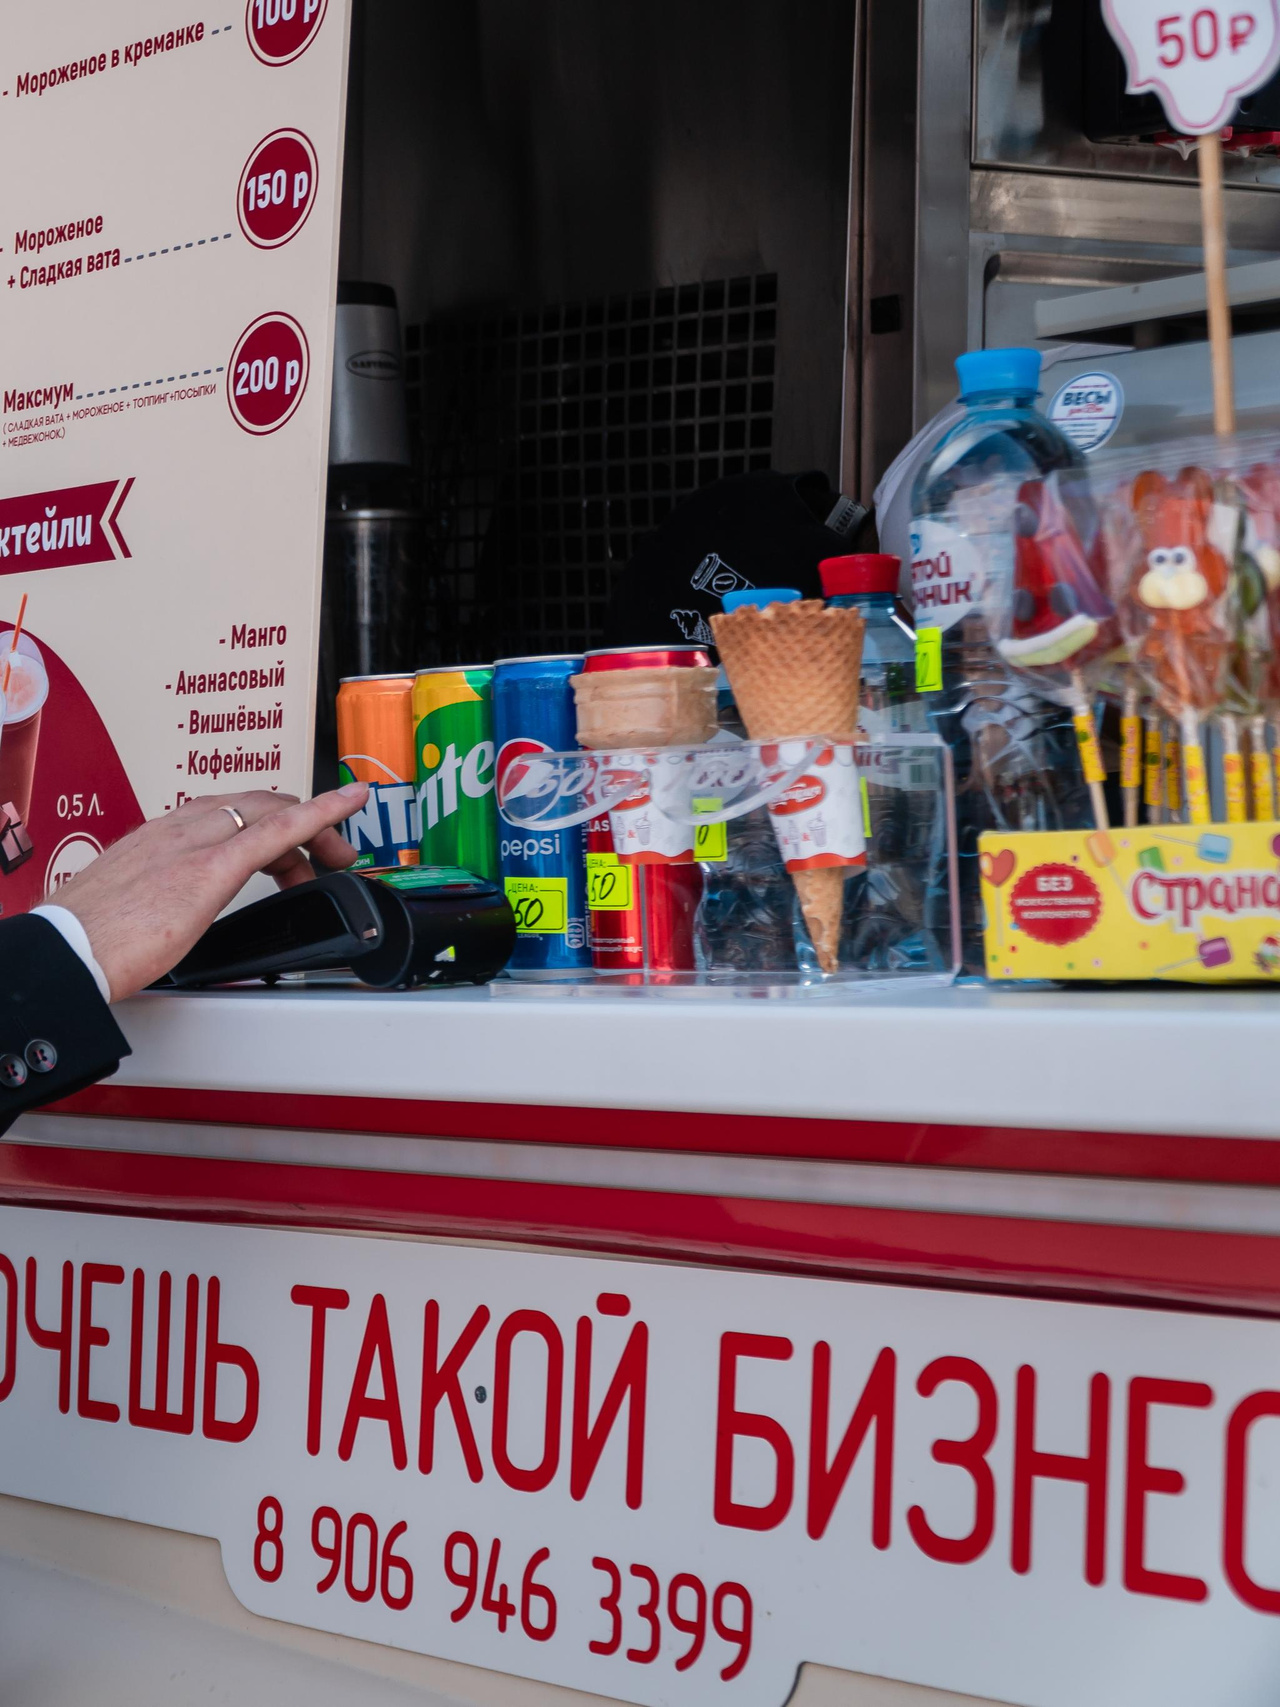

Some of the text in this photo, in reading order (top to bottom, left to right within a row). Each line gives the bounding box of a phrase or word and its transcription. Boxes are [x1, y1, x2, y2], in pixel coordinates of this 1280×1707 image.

[254, 0, 300, 30] 100
[16, 22, 204, 98] Мороженое в креманке
[246, 169, 287, 211] 150
[15, 215, 103, 254] Мороженое
[20, 258, 82, 290] Сладкая
[87, 248, 121, 273] вата
[236, 356, 280, 396] 200
[3, 382, 74, 413] Максмум
[8, 416, 44, 433] СЛАДКАЯ
[46, 412, 65, 425] ВАТА
[72, 401, 124, 420] МОРОЖЕНОЕ
[133, 392, 169, 408] ТОППИНГ
[231, 624, 287, 650] Манго
[175, 660, 285, 696] Ананасовый
[189, 702, 283, 735] Вишнёвый
[187, 744, 281, 779] Кофейный
[56, 793, 104, 820] 0,5 Л.
[501, 833, 561, 861] pepsi
[511, 883, 540, 893] ЦЕНА:
[590, 872, 617, 902] 50
[1036, 876, 1073, 891] БЕЗ
[514, 897, 544, 928] 50
[290, 1284, 650, 1510] ТАКОЙ
[713, 1331, 1280, 1618] БИЗНЕС
[254, 1496, 754, 1682] 8 906 946 3399
